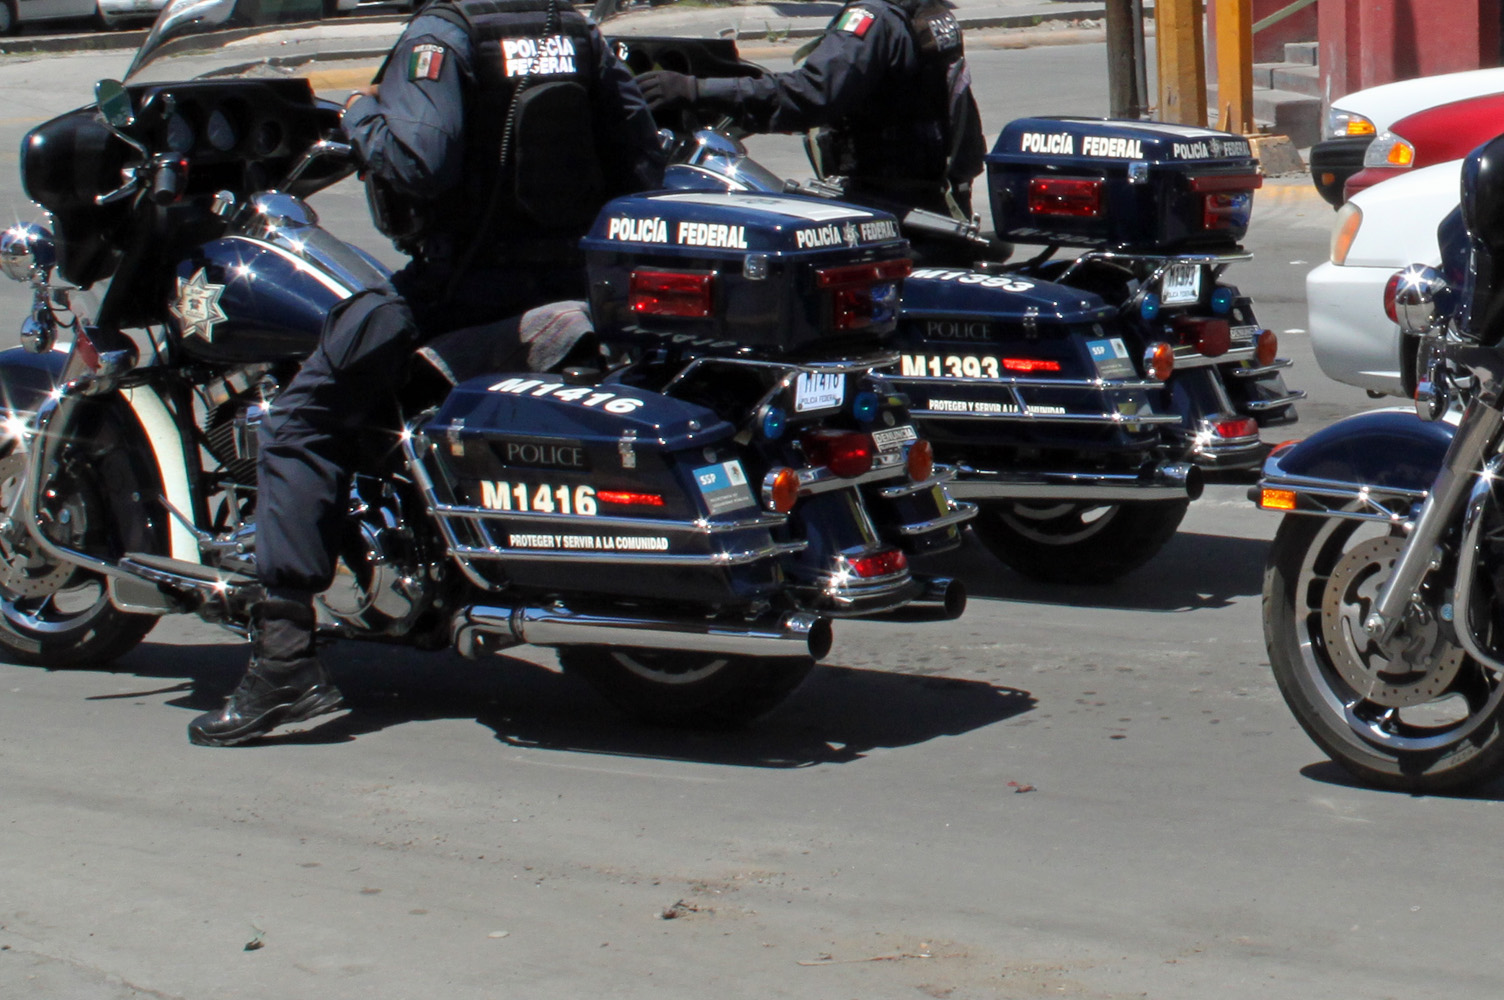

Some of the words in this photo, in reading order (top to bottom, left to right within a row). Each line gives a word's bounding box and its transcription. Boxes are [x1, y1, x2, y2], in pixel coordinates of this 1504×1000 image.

[1021, 132, 1074, 156] POLICÍA
[1082, 136, 1144, 160] FEDERAL
[1173, 141, 1209, 160] POLICÍA
[608, 216, 668, 243] POLICÍA
[677, 221, 748, 249] FEDERAL
[796, 224, 842, 249] POLICÍA
[860, 220, 897, 241] FEDERAL
[908, 267, 1035, 293] M1393
[927, 321, 991, 339] POLICE
[901, 354, 999, 379] M1393
[488, 377, 644, 413] M1416
[929, 398, 967, 412] PROTEGER
[967, 401, 974, 411] Y
[974, 402, 1002, 412] SERVIR
[507, 442, 584, 467] POLICE
[699, 474, 716, 486] SSP
[480, 479, 598, 516] M1416
[509, 534, 555, 548] PROTEGER
[555, 535, 563, 547] Y
[563, 535, 594, 549] SERVIR
[595, 536, 603, 549] A
[603, 537, 615, 549] LA
[615, 536, 669, 550] COMUNIDAD
